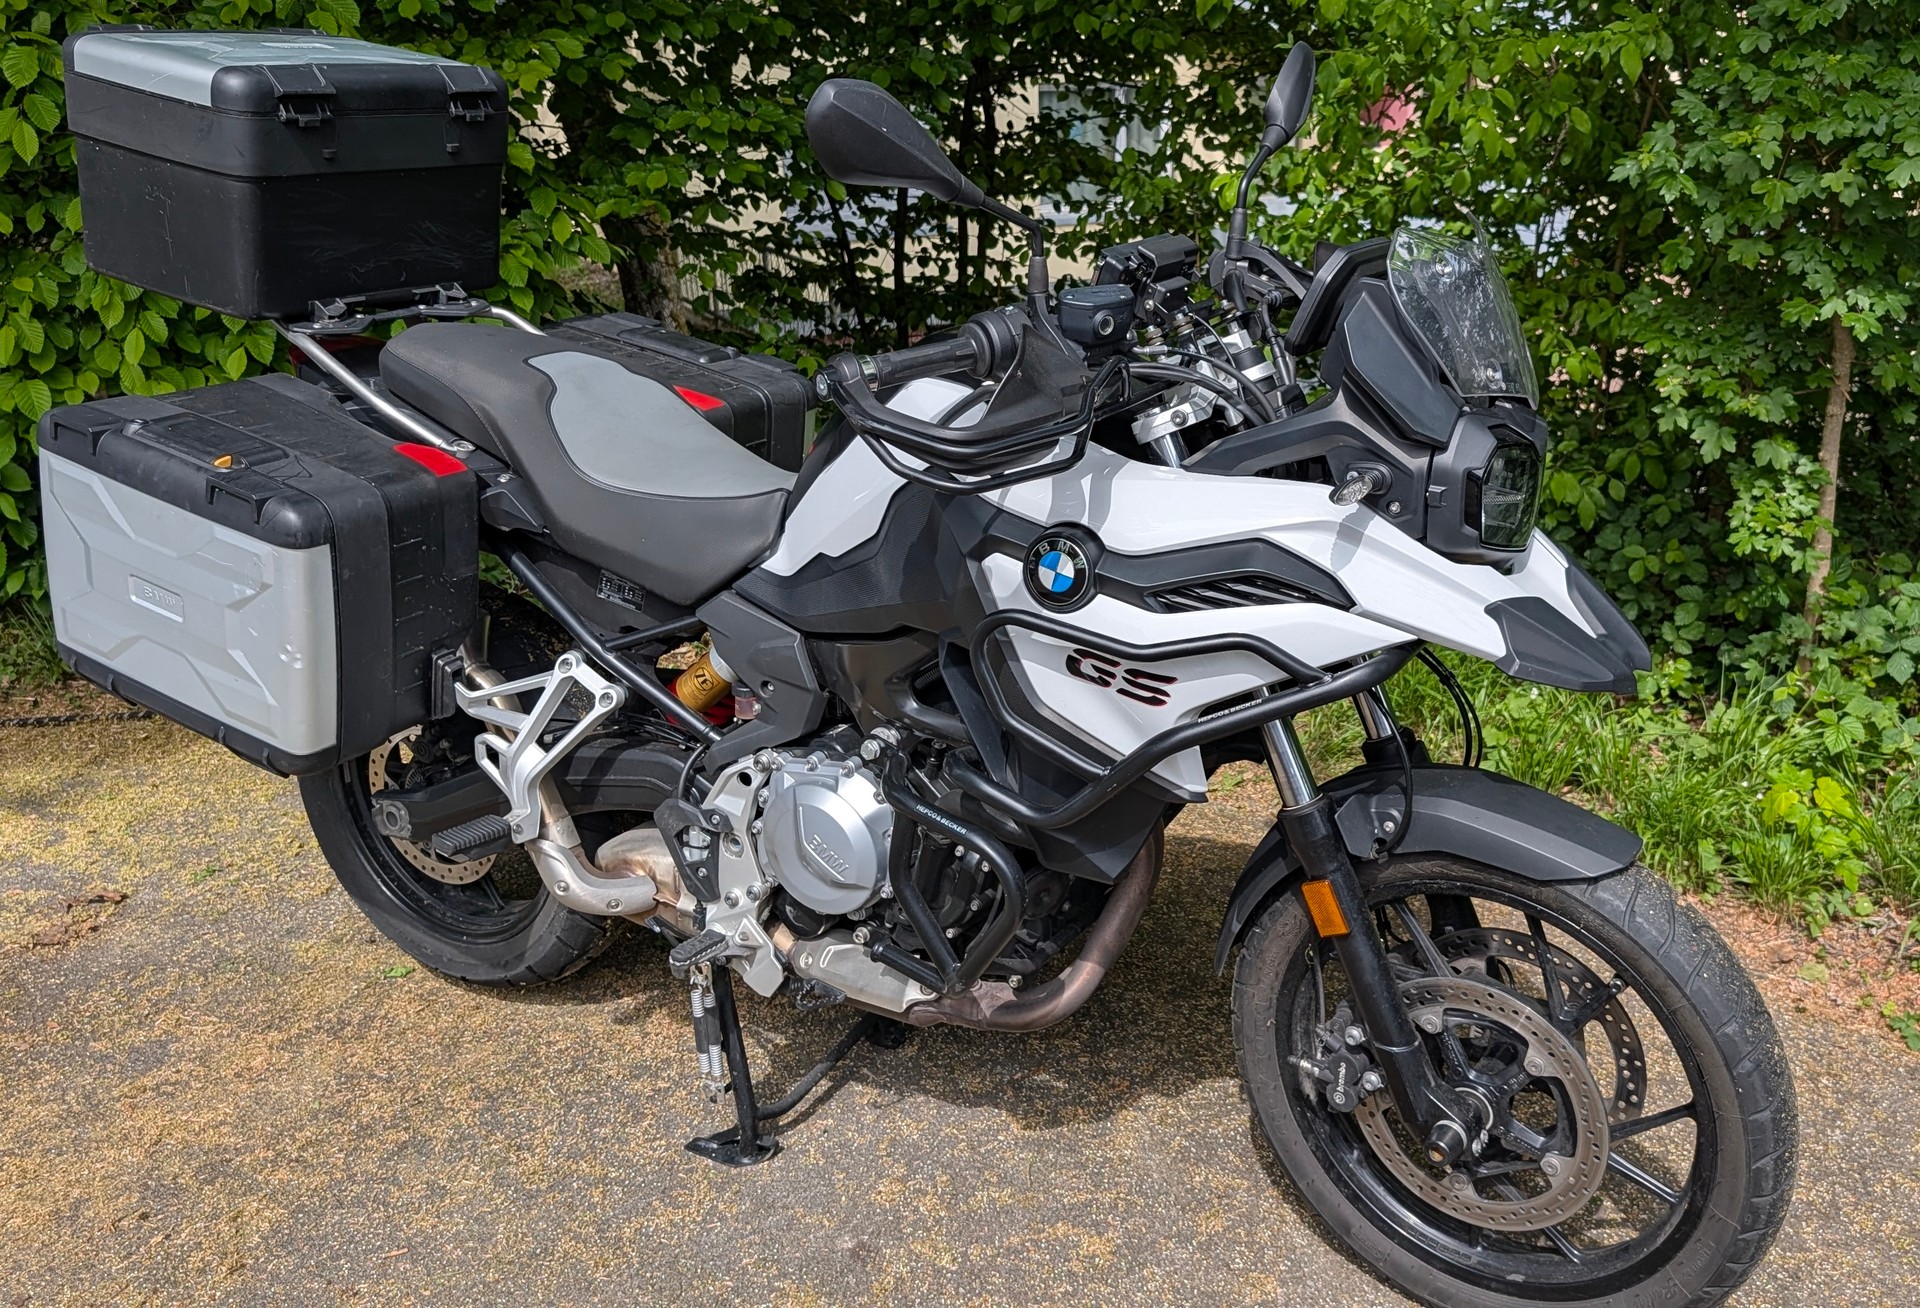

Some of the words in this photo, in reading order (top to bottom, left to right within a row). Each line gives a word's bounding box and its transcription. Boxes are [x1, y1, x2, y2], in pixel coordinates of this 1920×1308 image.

[1038, 541, 1085, 569] BMW
[1066, 648, 1178, 707] GS
[809, 834, 849, 874] BMW
[1336, 1062, 1347, 1093] brembo
